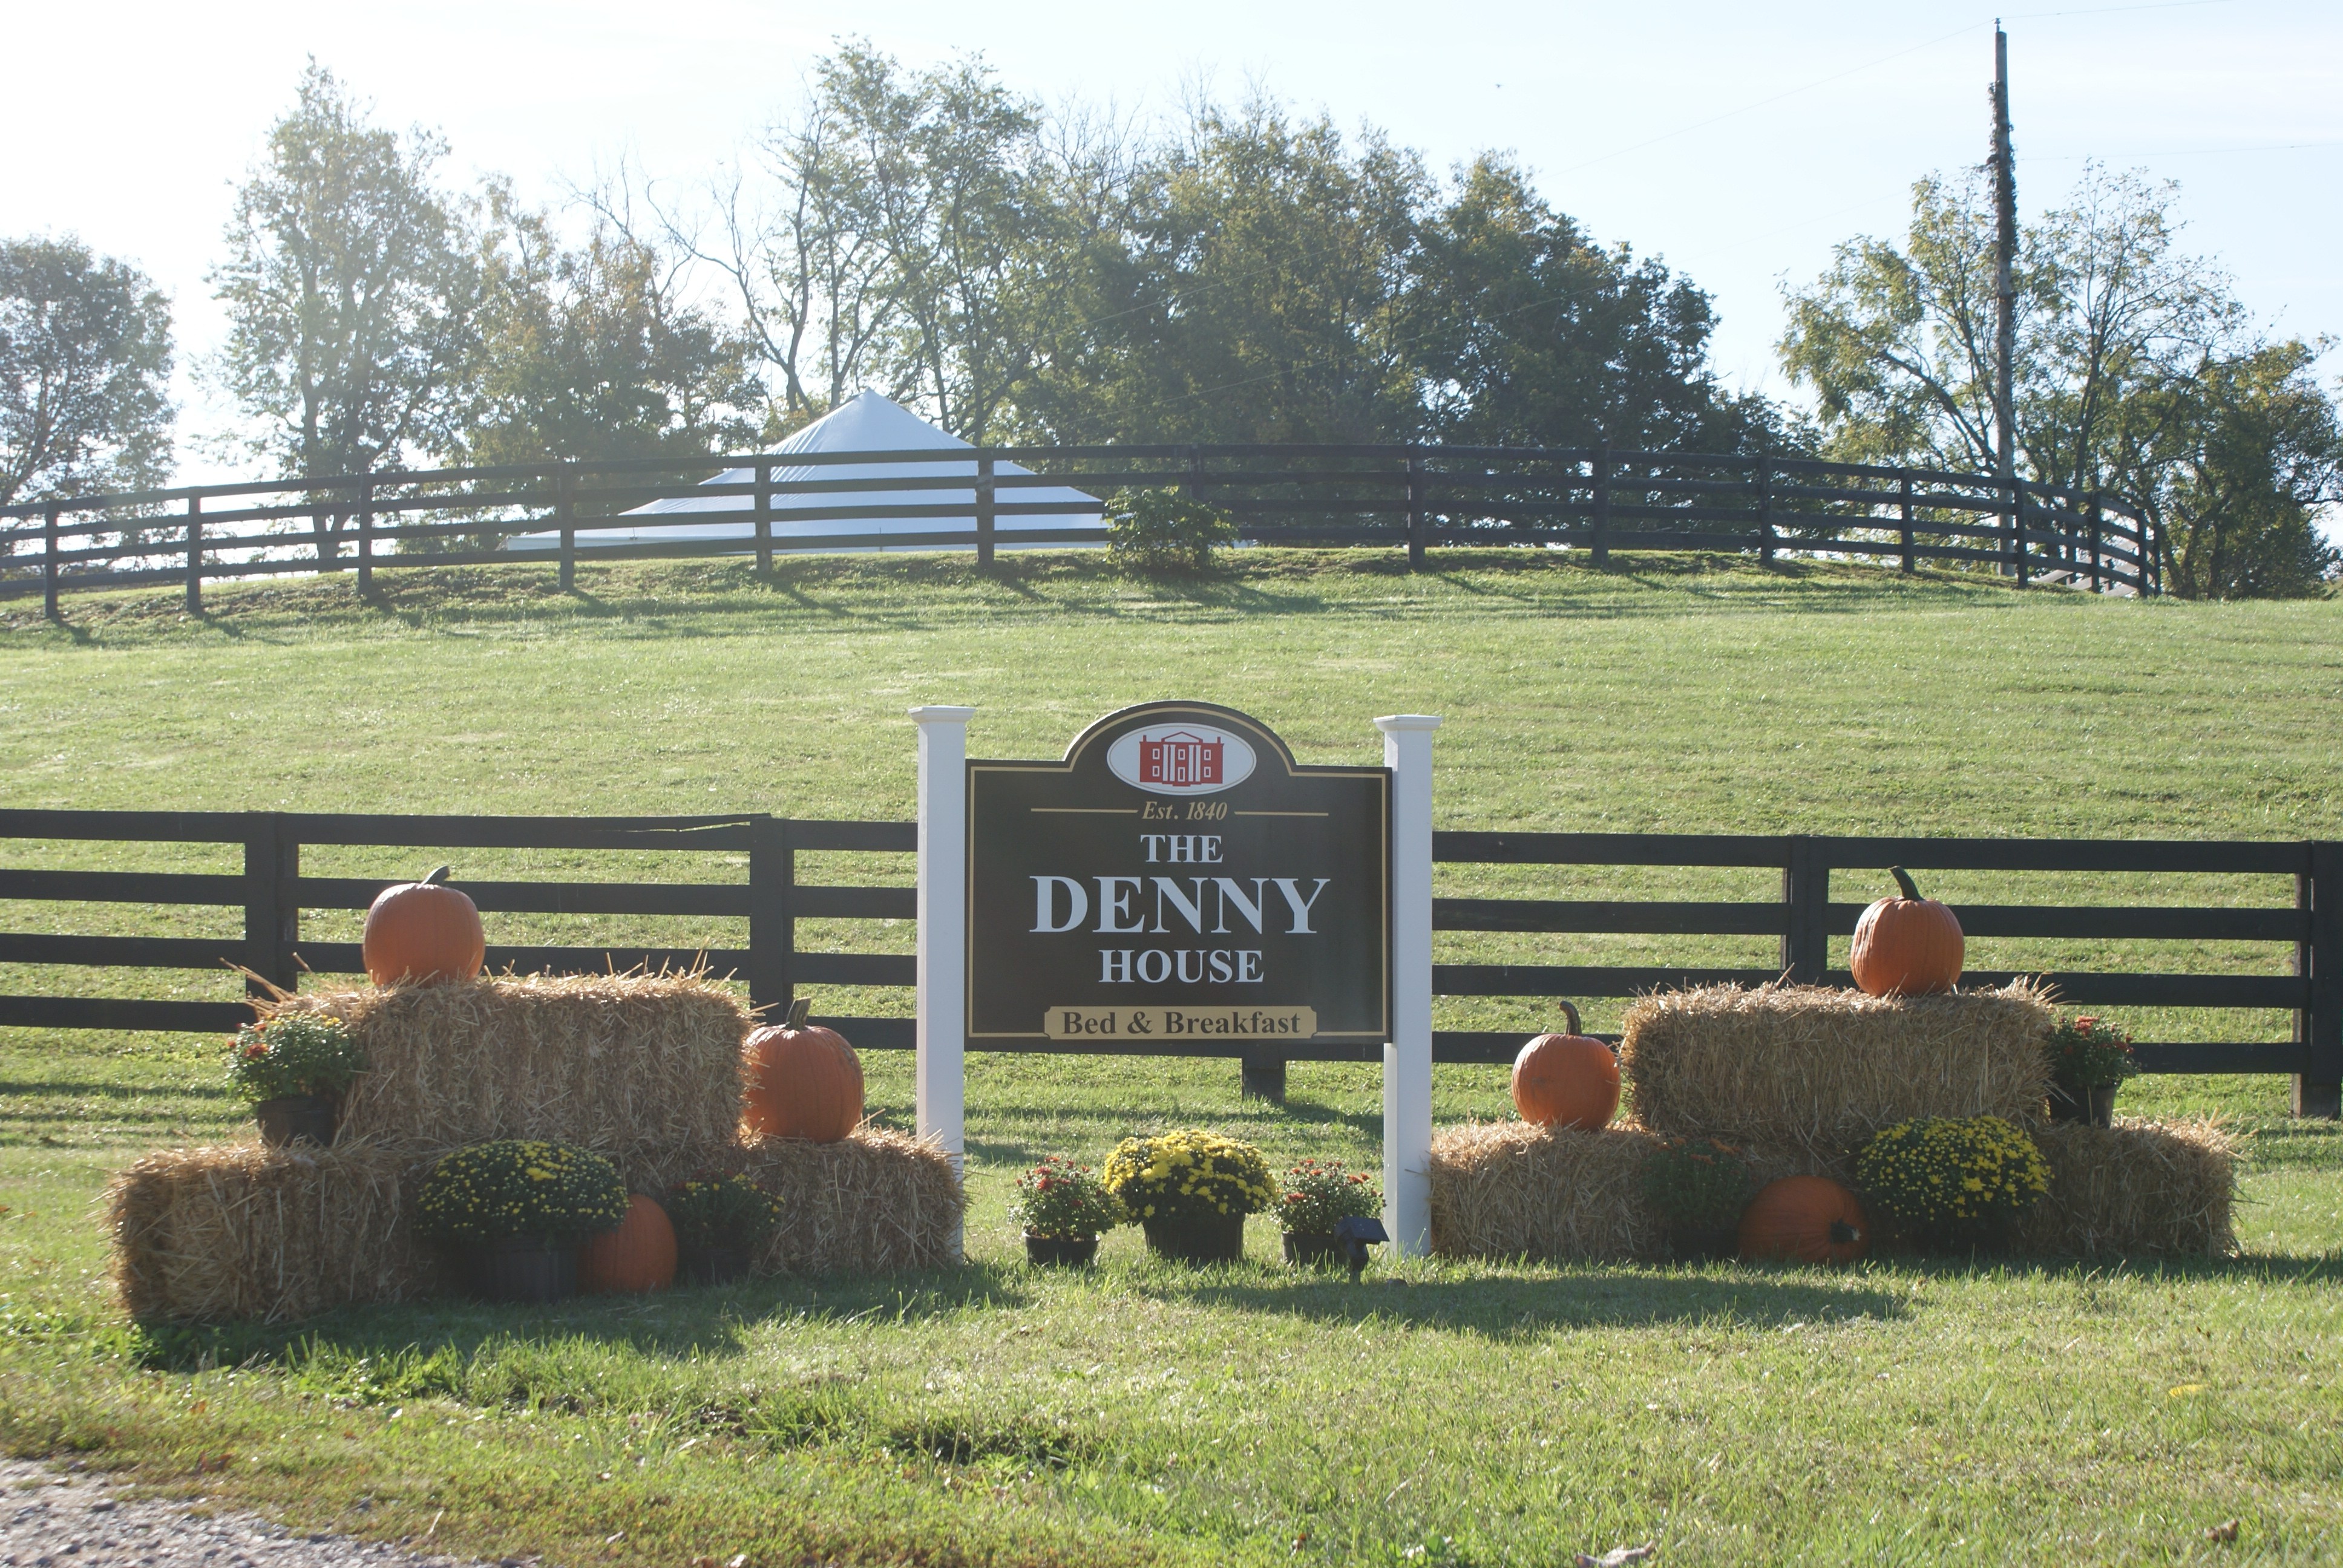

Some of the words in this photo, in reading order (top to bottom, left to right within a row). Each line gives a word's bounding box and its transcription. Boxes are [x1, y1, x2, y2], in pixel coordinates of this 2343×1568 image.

[1142, 802, 1179, 820] Est.
[1186, 802, 1228, 820] 1840
[1140, 834, 1224, 863] THE
[1029, 875, 1331, 935] DENNY
[1098, 950, 1265, 983] HOUSE
[1062, 1011, 1116, 1034] Bed
[1127, 1011, 1153, 1034] &
[1164, 1011, 1300, 1035] Breakfast
